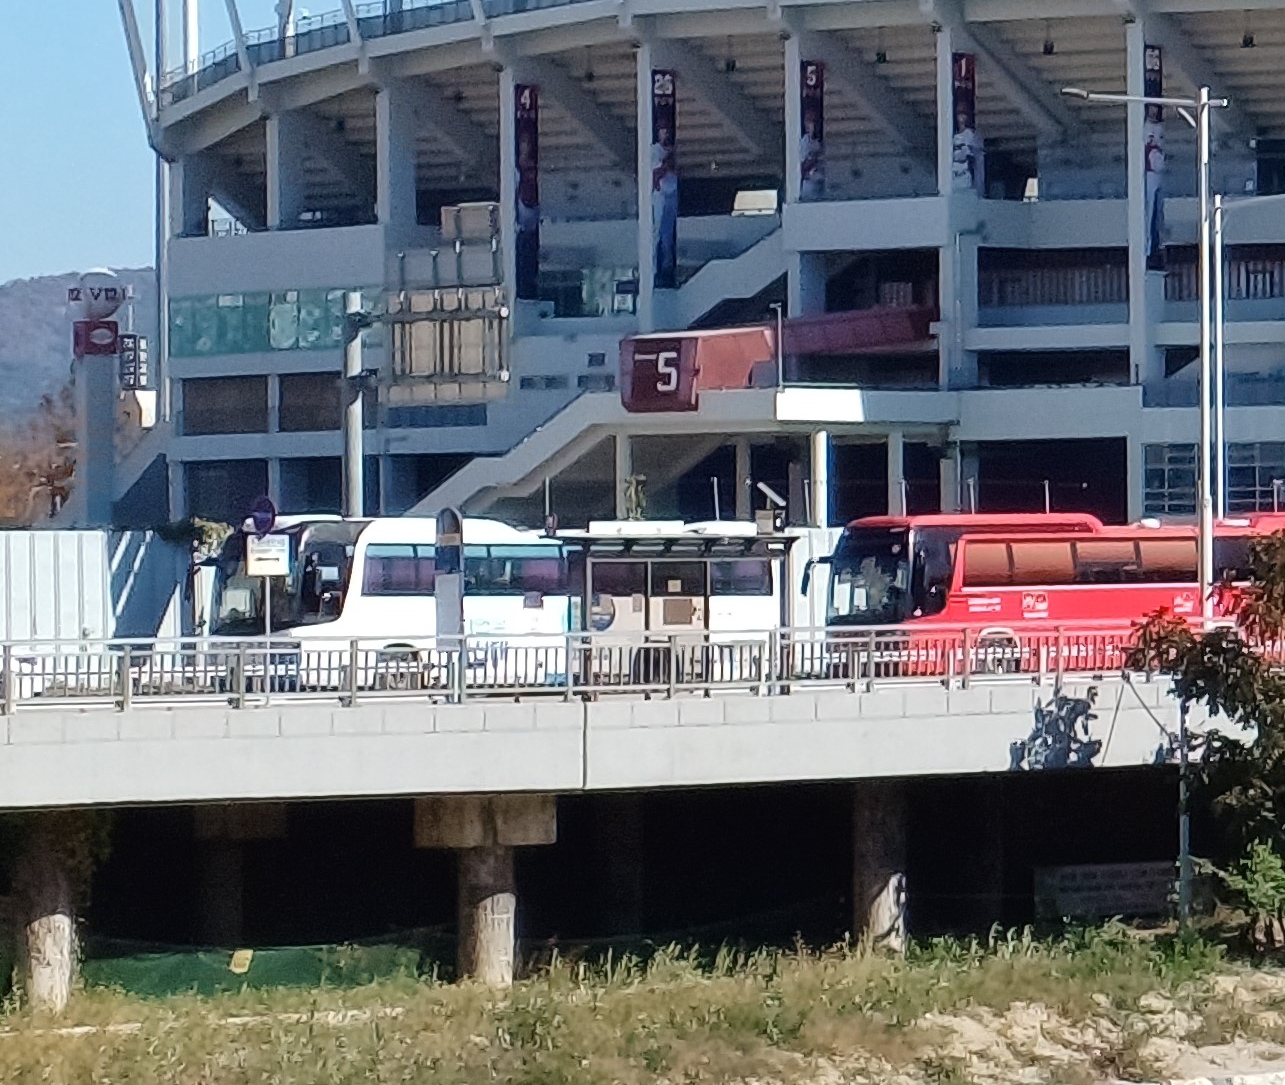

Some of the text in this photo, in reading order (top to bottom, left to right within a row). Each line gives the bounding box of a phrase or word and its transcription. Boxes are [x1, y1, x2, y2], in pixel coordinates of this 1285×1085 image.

[807, 66, 816, 85] 5
[521, 88, 530, 109] 4
[657, 351, 678, 392] 5
